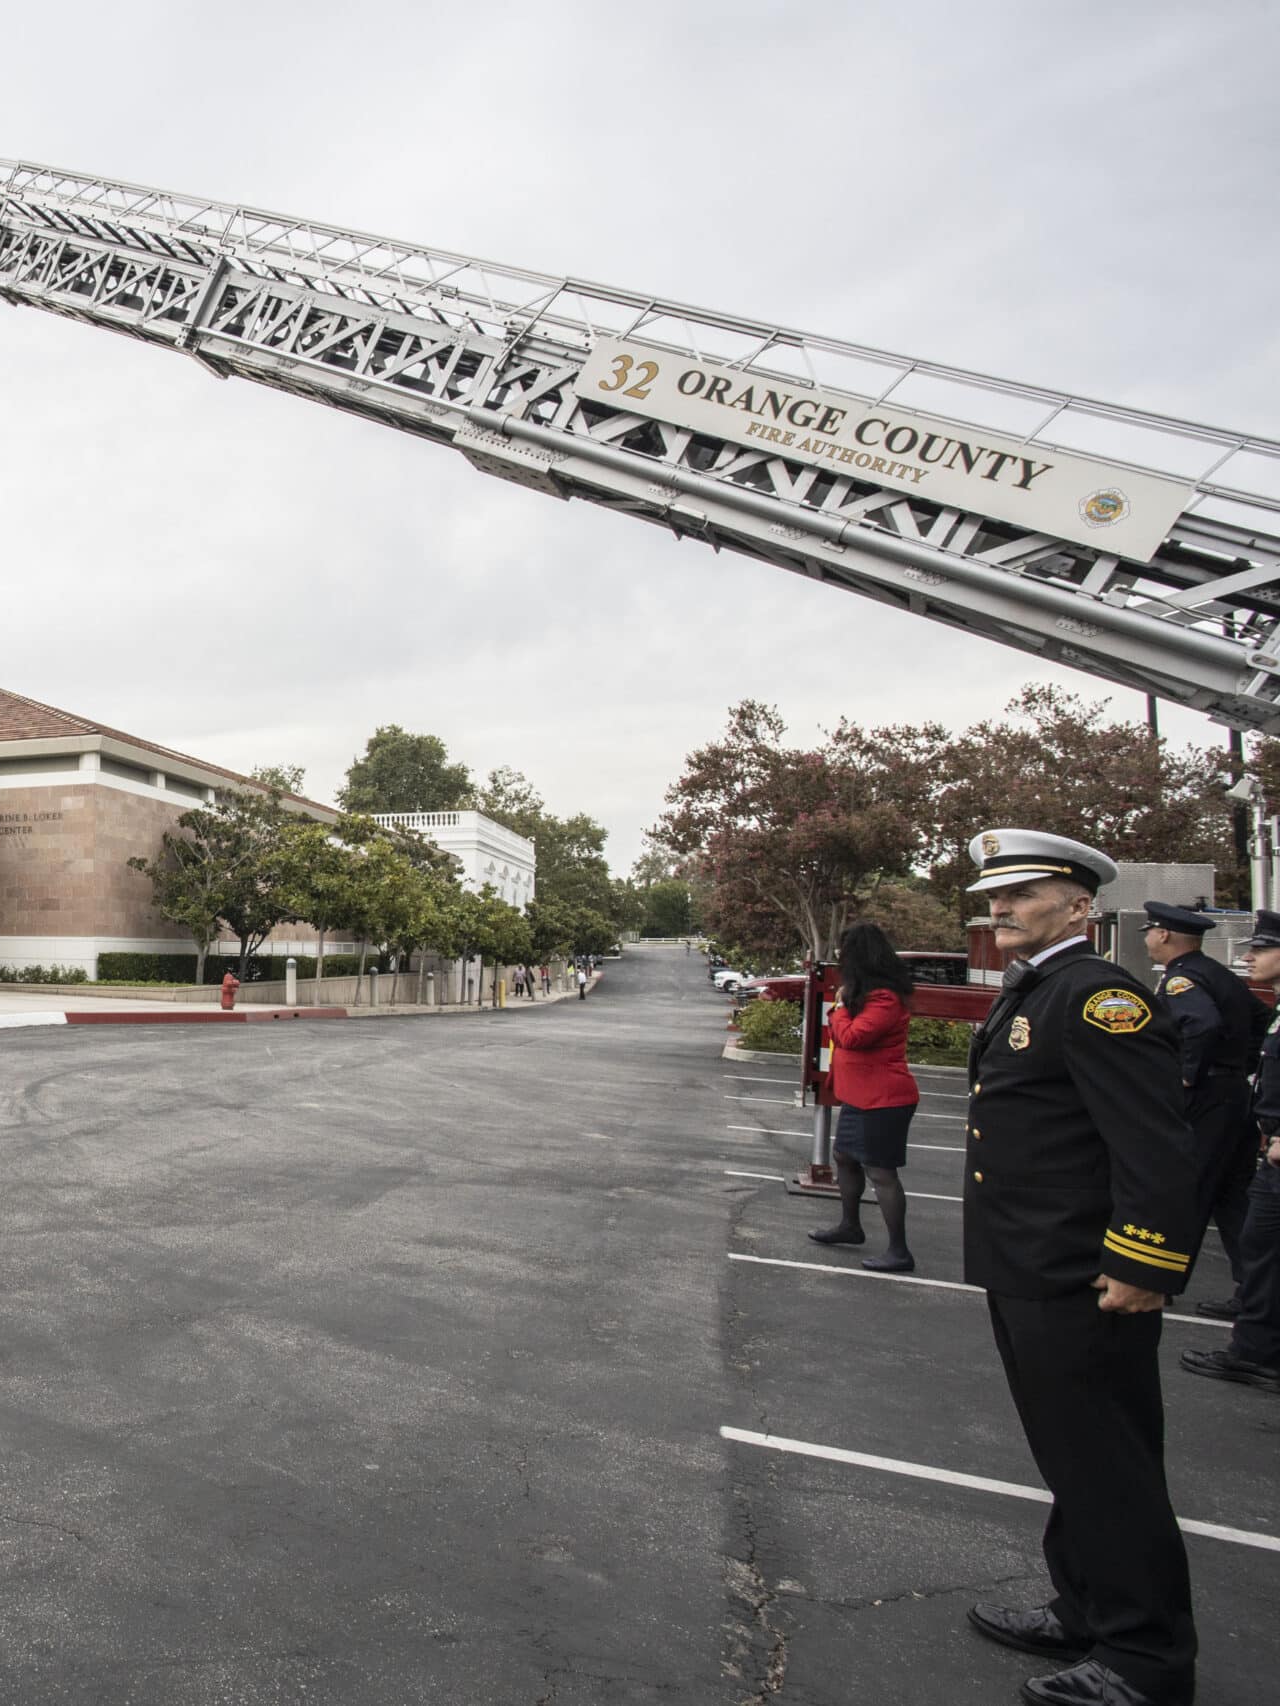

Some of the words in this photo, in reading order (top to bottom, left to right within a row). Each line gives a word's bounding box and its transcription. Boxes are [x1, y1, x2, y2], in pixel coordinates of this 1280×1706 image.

[597, 354, 660, 401] 32
[676, 369, 848, 436] ORANGE
[854, 413, 1055, 491] COUNTY
[745, 421, 795, 448] FIRE
[796, 436, 929, 486] AUTHORITY
[1087, 991, 1113, 1012] ORANGE
[1117, 991, 1145, 1009] COUNTY
